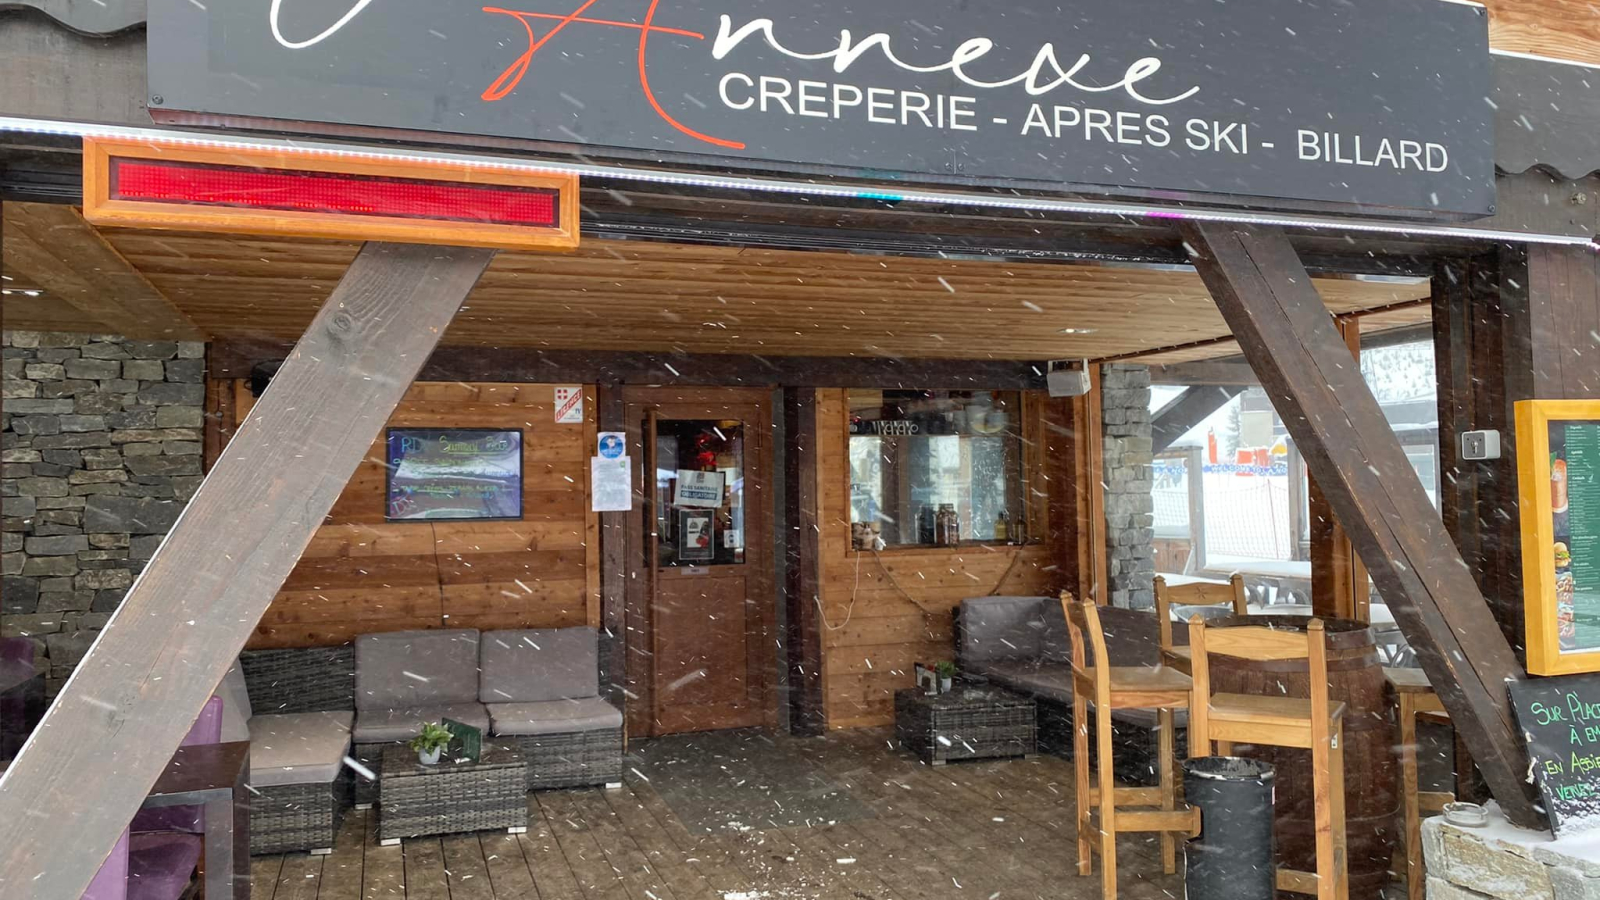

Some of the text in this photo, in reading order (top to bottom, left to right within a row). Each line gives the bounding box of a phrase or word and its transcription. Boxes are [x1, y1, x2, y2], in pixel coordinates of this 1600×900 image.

[718, 72, 978, 131] CREPERIE
[1020, 102, 1171, 148] APRES
[1184, 118, 1249, 155] SKI
[1297, 128, 1449, 173] BILLARD
